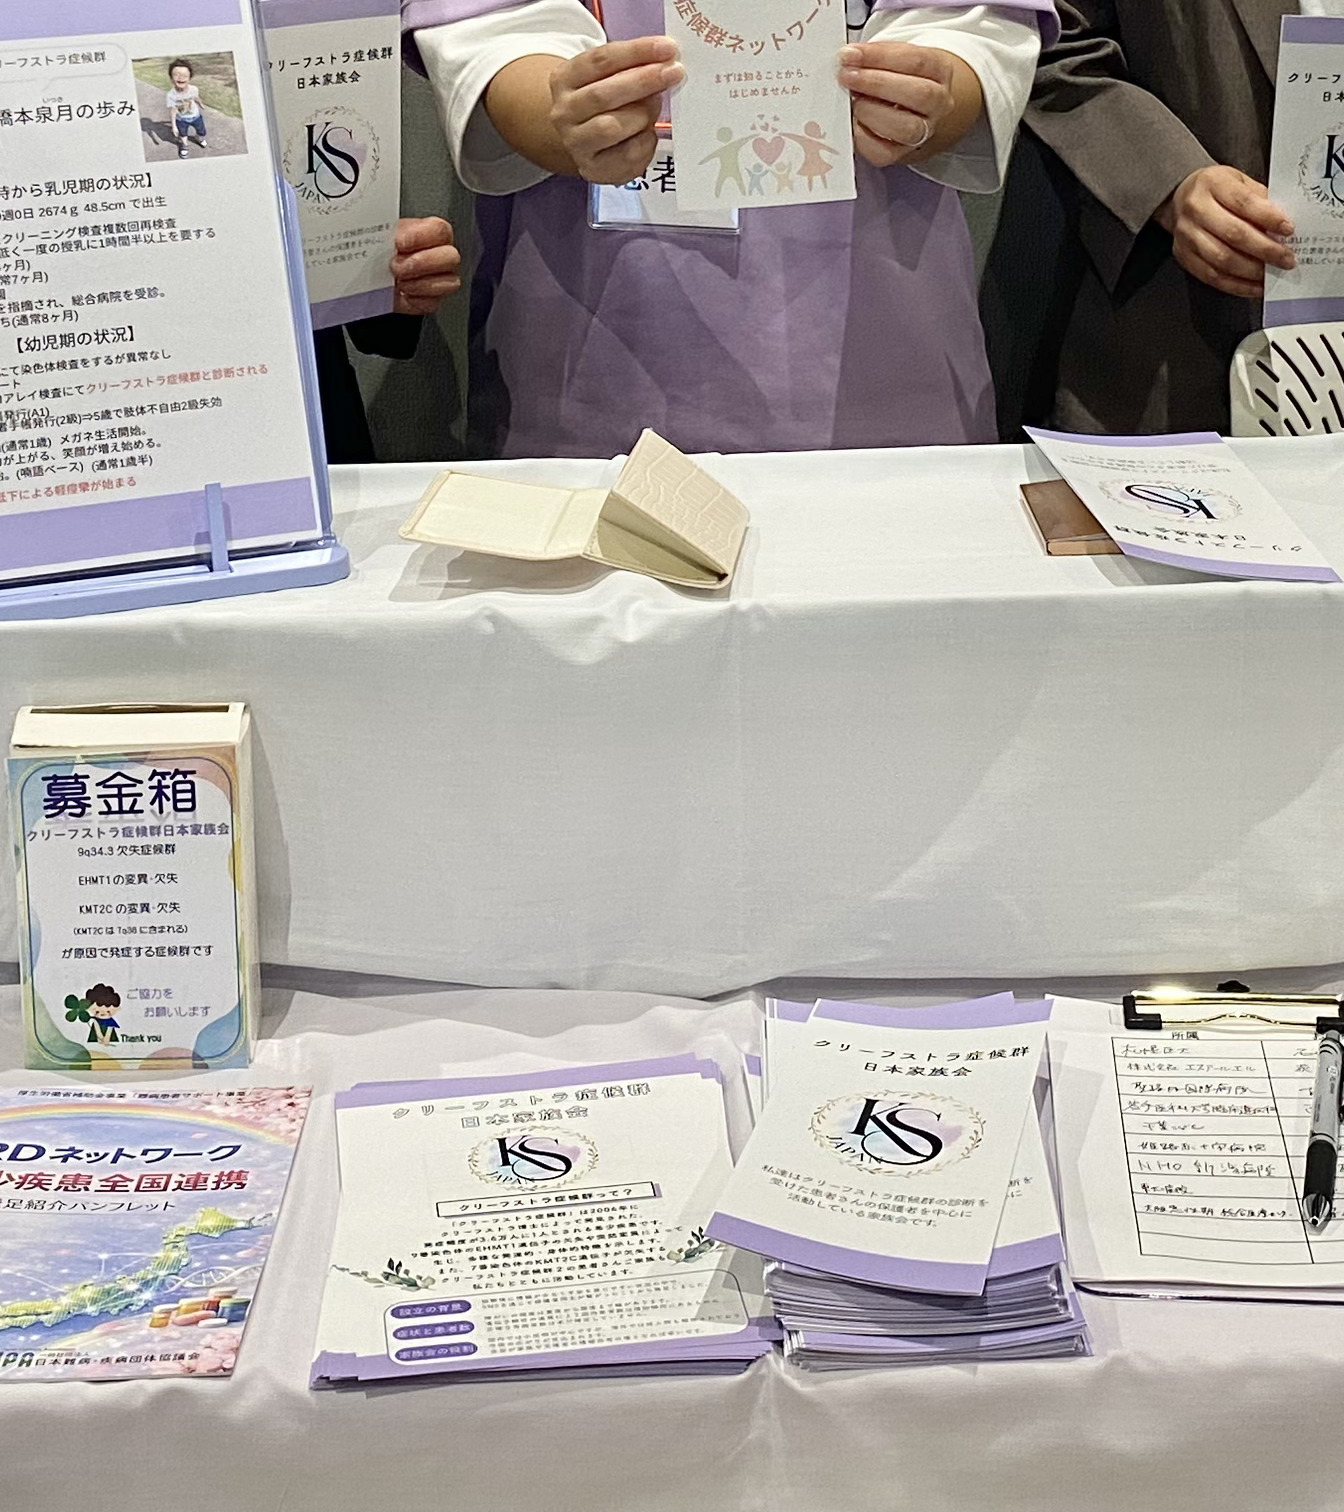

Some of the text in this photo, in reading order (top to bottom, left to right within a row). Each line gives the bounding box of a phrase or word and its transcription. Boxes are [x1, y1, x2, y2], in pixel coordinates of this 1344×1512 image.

[297, 70, 360, 89] 日本家族会
[714, 68, 810, 85] まずは知ることから、
[729, 85, 801, 99] はじめませんか
[306, 121, 360, 198] KS
[84, 199, 126, 212] 48.5cm
[129, 196, 167, 209] で出生
[13, 326, 138, 355] 【幼児期の状況】
[42, 768, 197, 819] 募金箱
[117, 843, 176, 856] 欠失症候群
[126, 987, 174, 1000] ご協力を
[144, 1005, 210, 1018] お願いします
[121, 1033, 162, 1044] Thank you
[813, 1040, 1030, 1061] クリーフストラ症候群
[864, 1062, 972, 1077] 日本家族会
[391, 1083, 652, 1120] クリーフストラ症候群
[460, 1104, 590, 1129] 日本家族会
[848, 1098, 942, 1166] KS
[826, 1135, 883, 1164] JAPAN
[35, 1352, 201, 1368] 日本難病・疾病団体協議会
